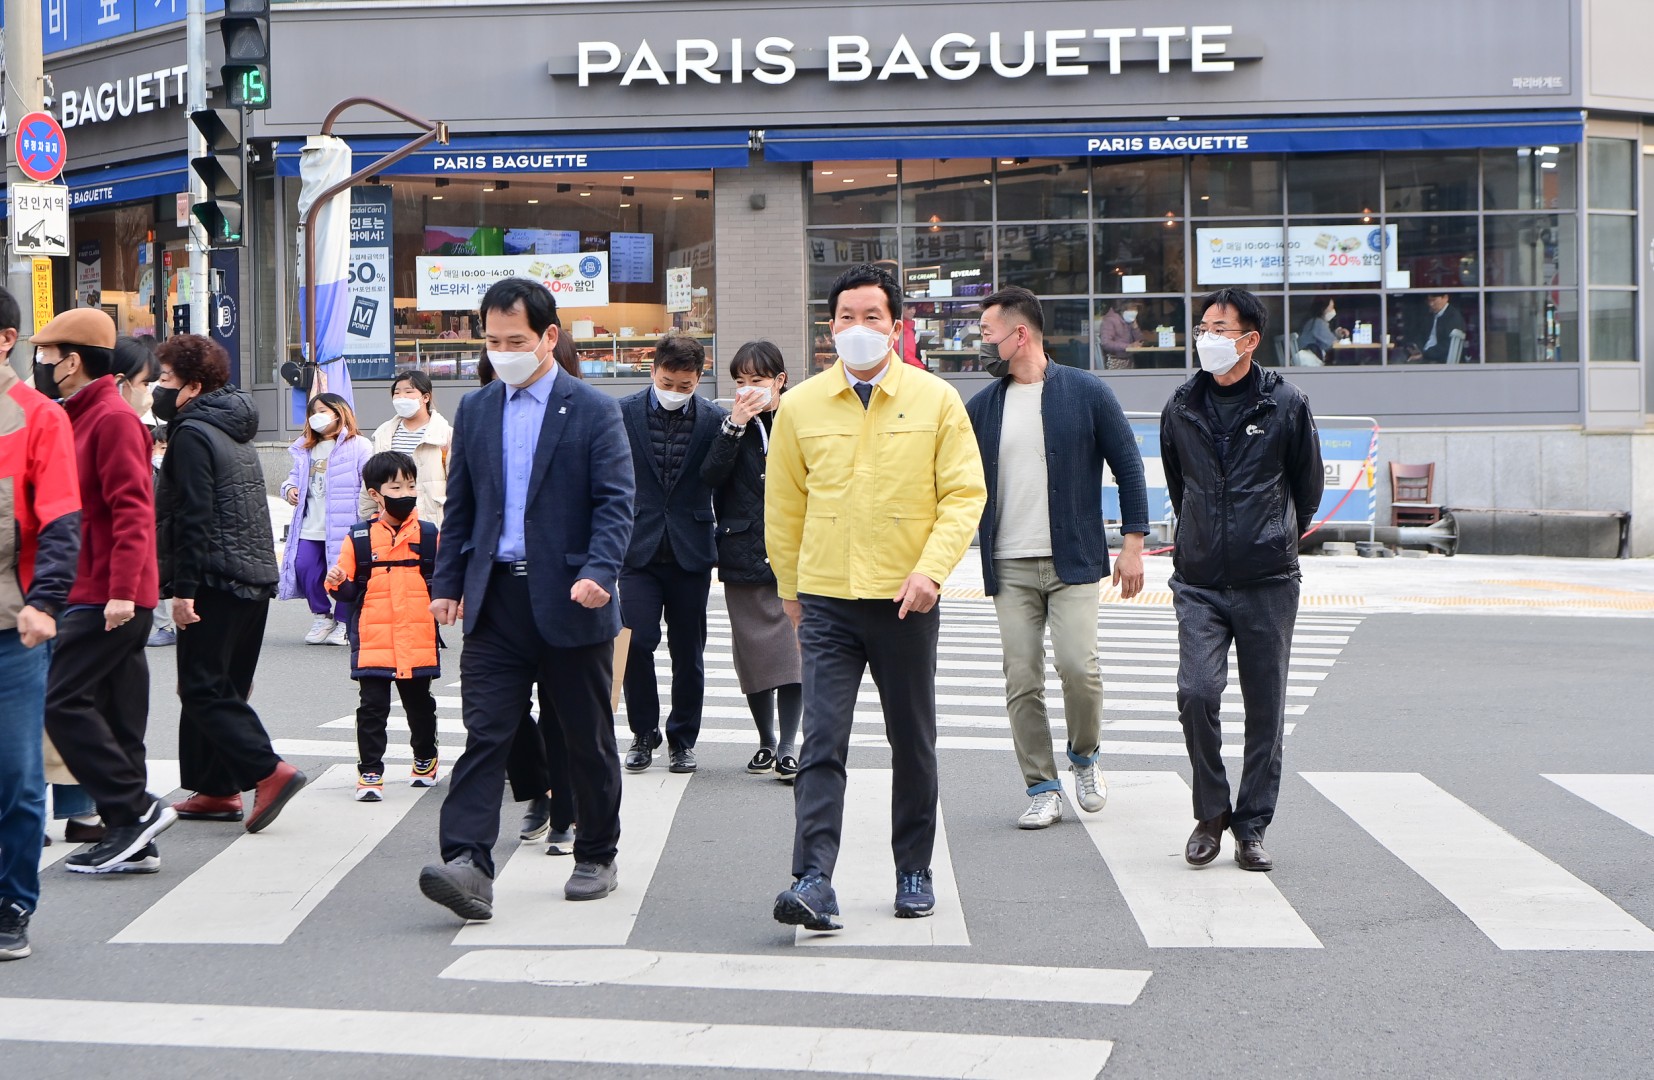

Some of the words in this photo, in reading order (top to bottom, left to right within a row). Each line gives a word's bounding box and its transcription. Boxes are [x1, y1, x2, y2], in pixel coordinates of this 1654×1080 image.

[577, 37, 796, 88] PARIS
[826, 25, 1236, 83] BAGUETTE
[243, 70, 265, 102] 15
[1512, 76, 1563, 89] 파리바게뜨
[61, 65, 188, 129] BAGUETT
[24, 139, 58, 154] 주정차금지
[1088, 138, 1143, 151] PARIS
[1149, 136, 1249, 150] BAGUETTE
[433, 156, 486, 170] PARIS
[492, 154, 588, 169] BAGUETTE
[74, 187, 113, 204] BAGUETTE
[18, 195, 64, 212] 견인지역
[350, 217, 384, 230] 인트는
[1294, 255, 1325, 267] 구매시
[1328, 253, 1361, 266] 20%
[444, 270, 459, 278] 매일
[950, 268, 981, 278] BEVERAGE
[574, 280, 595, 292] 할인
[353, 305, 374, 325] M
[352, 321, 370, 331] POINT
